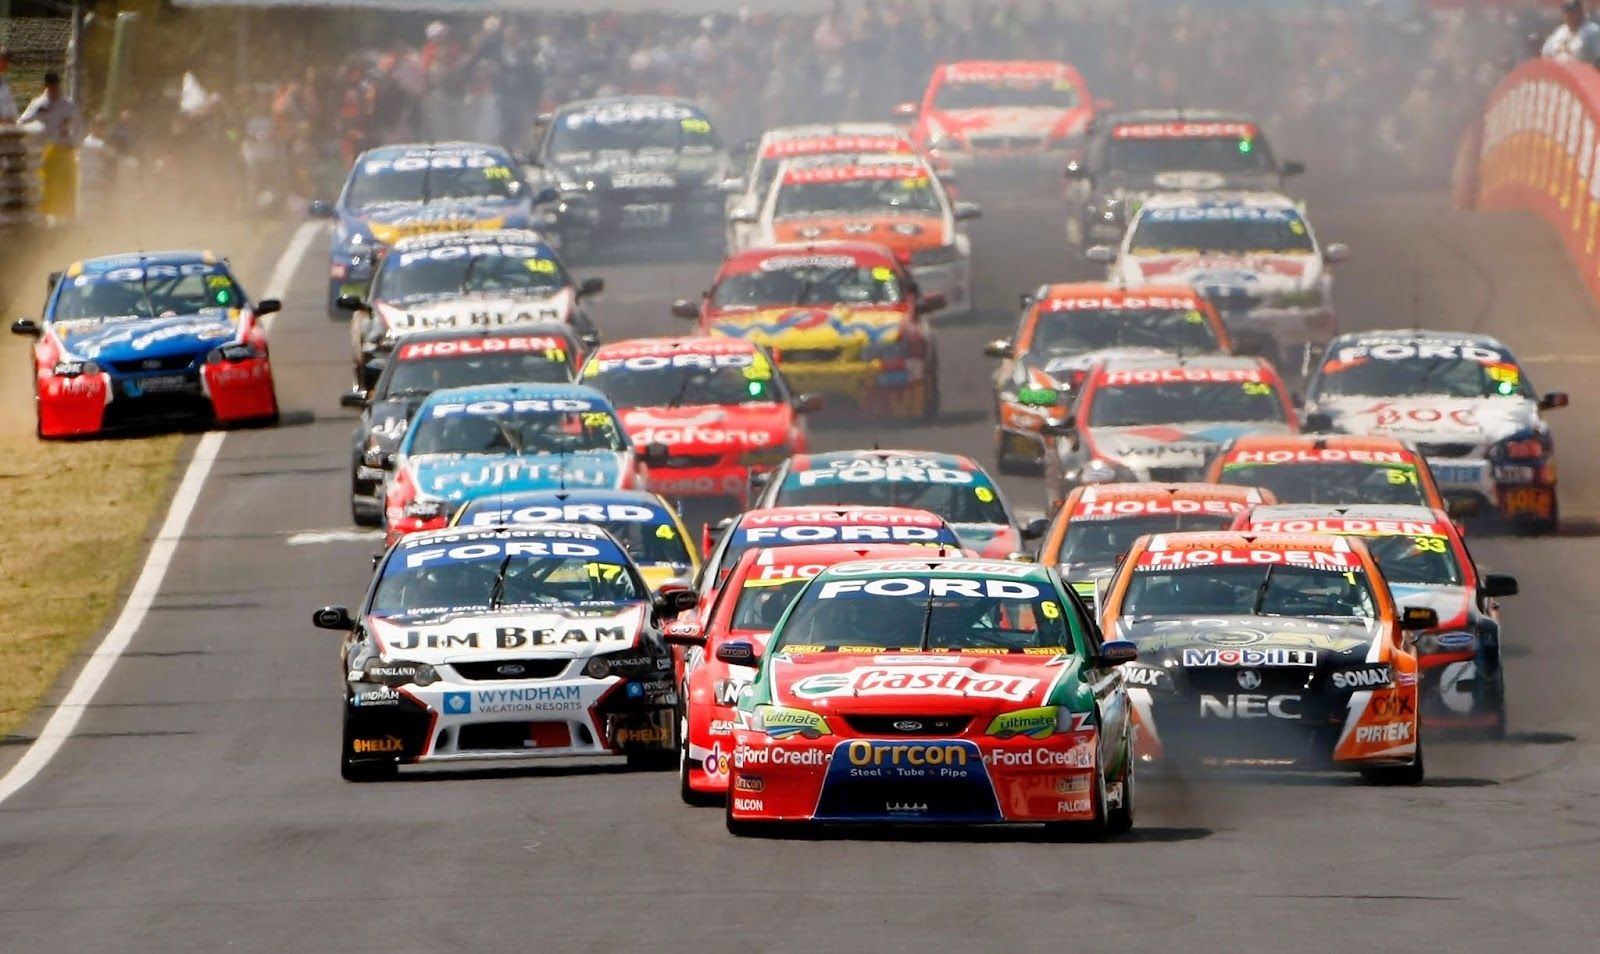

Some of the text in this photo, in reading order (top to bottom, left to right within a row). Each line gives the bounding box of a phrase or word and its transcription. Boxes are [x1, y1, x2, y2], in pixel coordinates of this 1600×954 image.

[365, 155, 497, 176] FORD
[400, 244, 538, 267] FORD
[1051, 297, 1195, 311] HOLDEN
[407, 337, 556, 356] HOLDEN
[1339, 345, 1501, 363] FORD
[598, 354, 753, 372] FORD
[1107, 369, 1260, 383] HOLDEN
[432, 400, 591, 418] FORD
[632, 426, 770, 445] dafone
[830, 457, 940, 469] CALTEX
[1236, 449, 1401, 463] HOLDEN
[800, 466, 973, 486] FORD
[473, 504, 654, 525] FORD
[1083, 500, 1254, 515] HOLDEN
[751, 511, 932, 525] vodafone
[1253, 519, 1434, 534] HOLDEN
[656, 524, 676, 540] 4
[747, 524, 938, 542] FORD
[1414, 537, 1445, 552] 33
[406, 542, 600, 568] FORD
[1151, 550, 1346, 564] HOLDEN
[583, 561, 622, 581] 17
[1343, 572, 1357, 585] 1
[819, 578, 1039, 599] FORD
[1041, 601, 1059, 618] 6
[390, 626, 627, 650] JIM BEAM
[1183, 649, 1287, 666] Mobil
[853, 668, 1028, 696] Castrol
[1120, 667, 1164, 685] NAX
[1332, 668, 1390, 688] SONAX
[478, 685, 581, 702] WYNDHAM
[479, 701, 582, 713] VACATION RESORTS
[1200, 694, 1302, 720] NEC
[766, 708, 820, 726] ultimate
[1000, 715, 1054, 729] ultimate
[1356, 722, 1412, 743] PIRTEK
[362, 739, 403, 752] HELIX
[849, 741, 967, 766] Orrcon
[744, 747, 823, 765] Ford Credit
[993, 749, 1032, 765] Ford
[850, 768, 968, 778] Steel Tube Pipe
[734, 798, 763, 811] FALCON
[1058, 799, 1091, 813] FALCON
